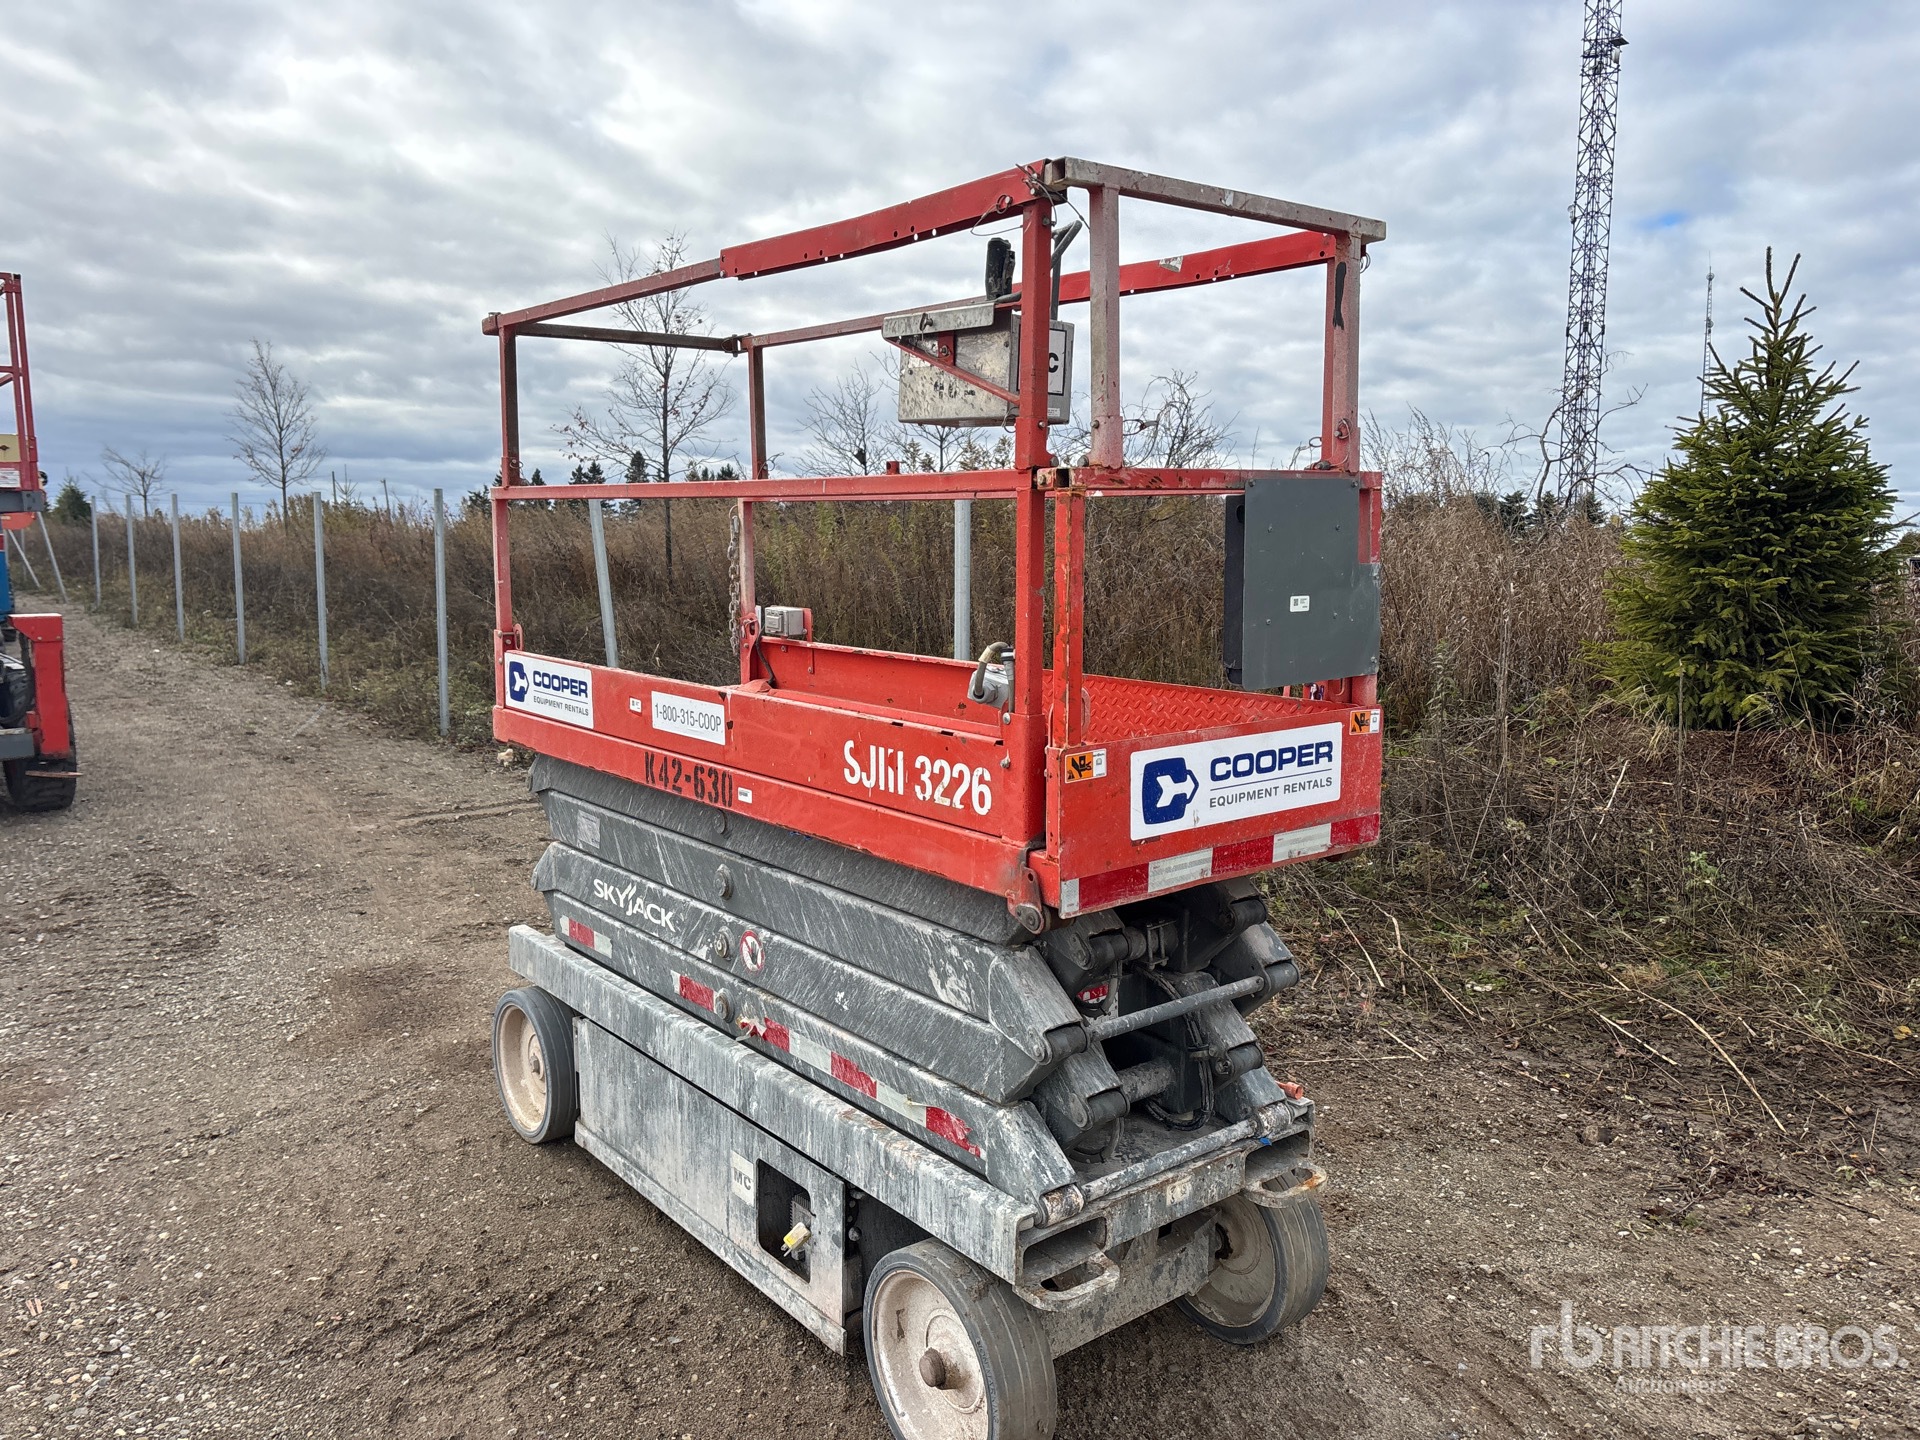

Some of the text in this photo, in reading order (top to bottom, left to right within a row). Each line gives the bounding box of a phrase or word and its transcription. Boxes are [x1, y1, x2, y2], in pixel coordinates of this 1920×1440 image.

[533, 670, 588, 698] COOPER
[533, 695, 589, 717] EQUIPMENT RENTALS
[654, 702, 722, 732] 1-800-315-COOP
[1210, 740, 1334, 782] COOPER
[645, 751, 733, 808] K42-630
[914, 754, 993, 816] 3226
[1209, 776, 1333, 809] EQUIPMENT RENTALS
[593, 878, 676, 932] SKYJACK
[733, 1166, 752, 1191] MC
